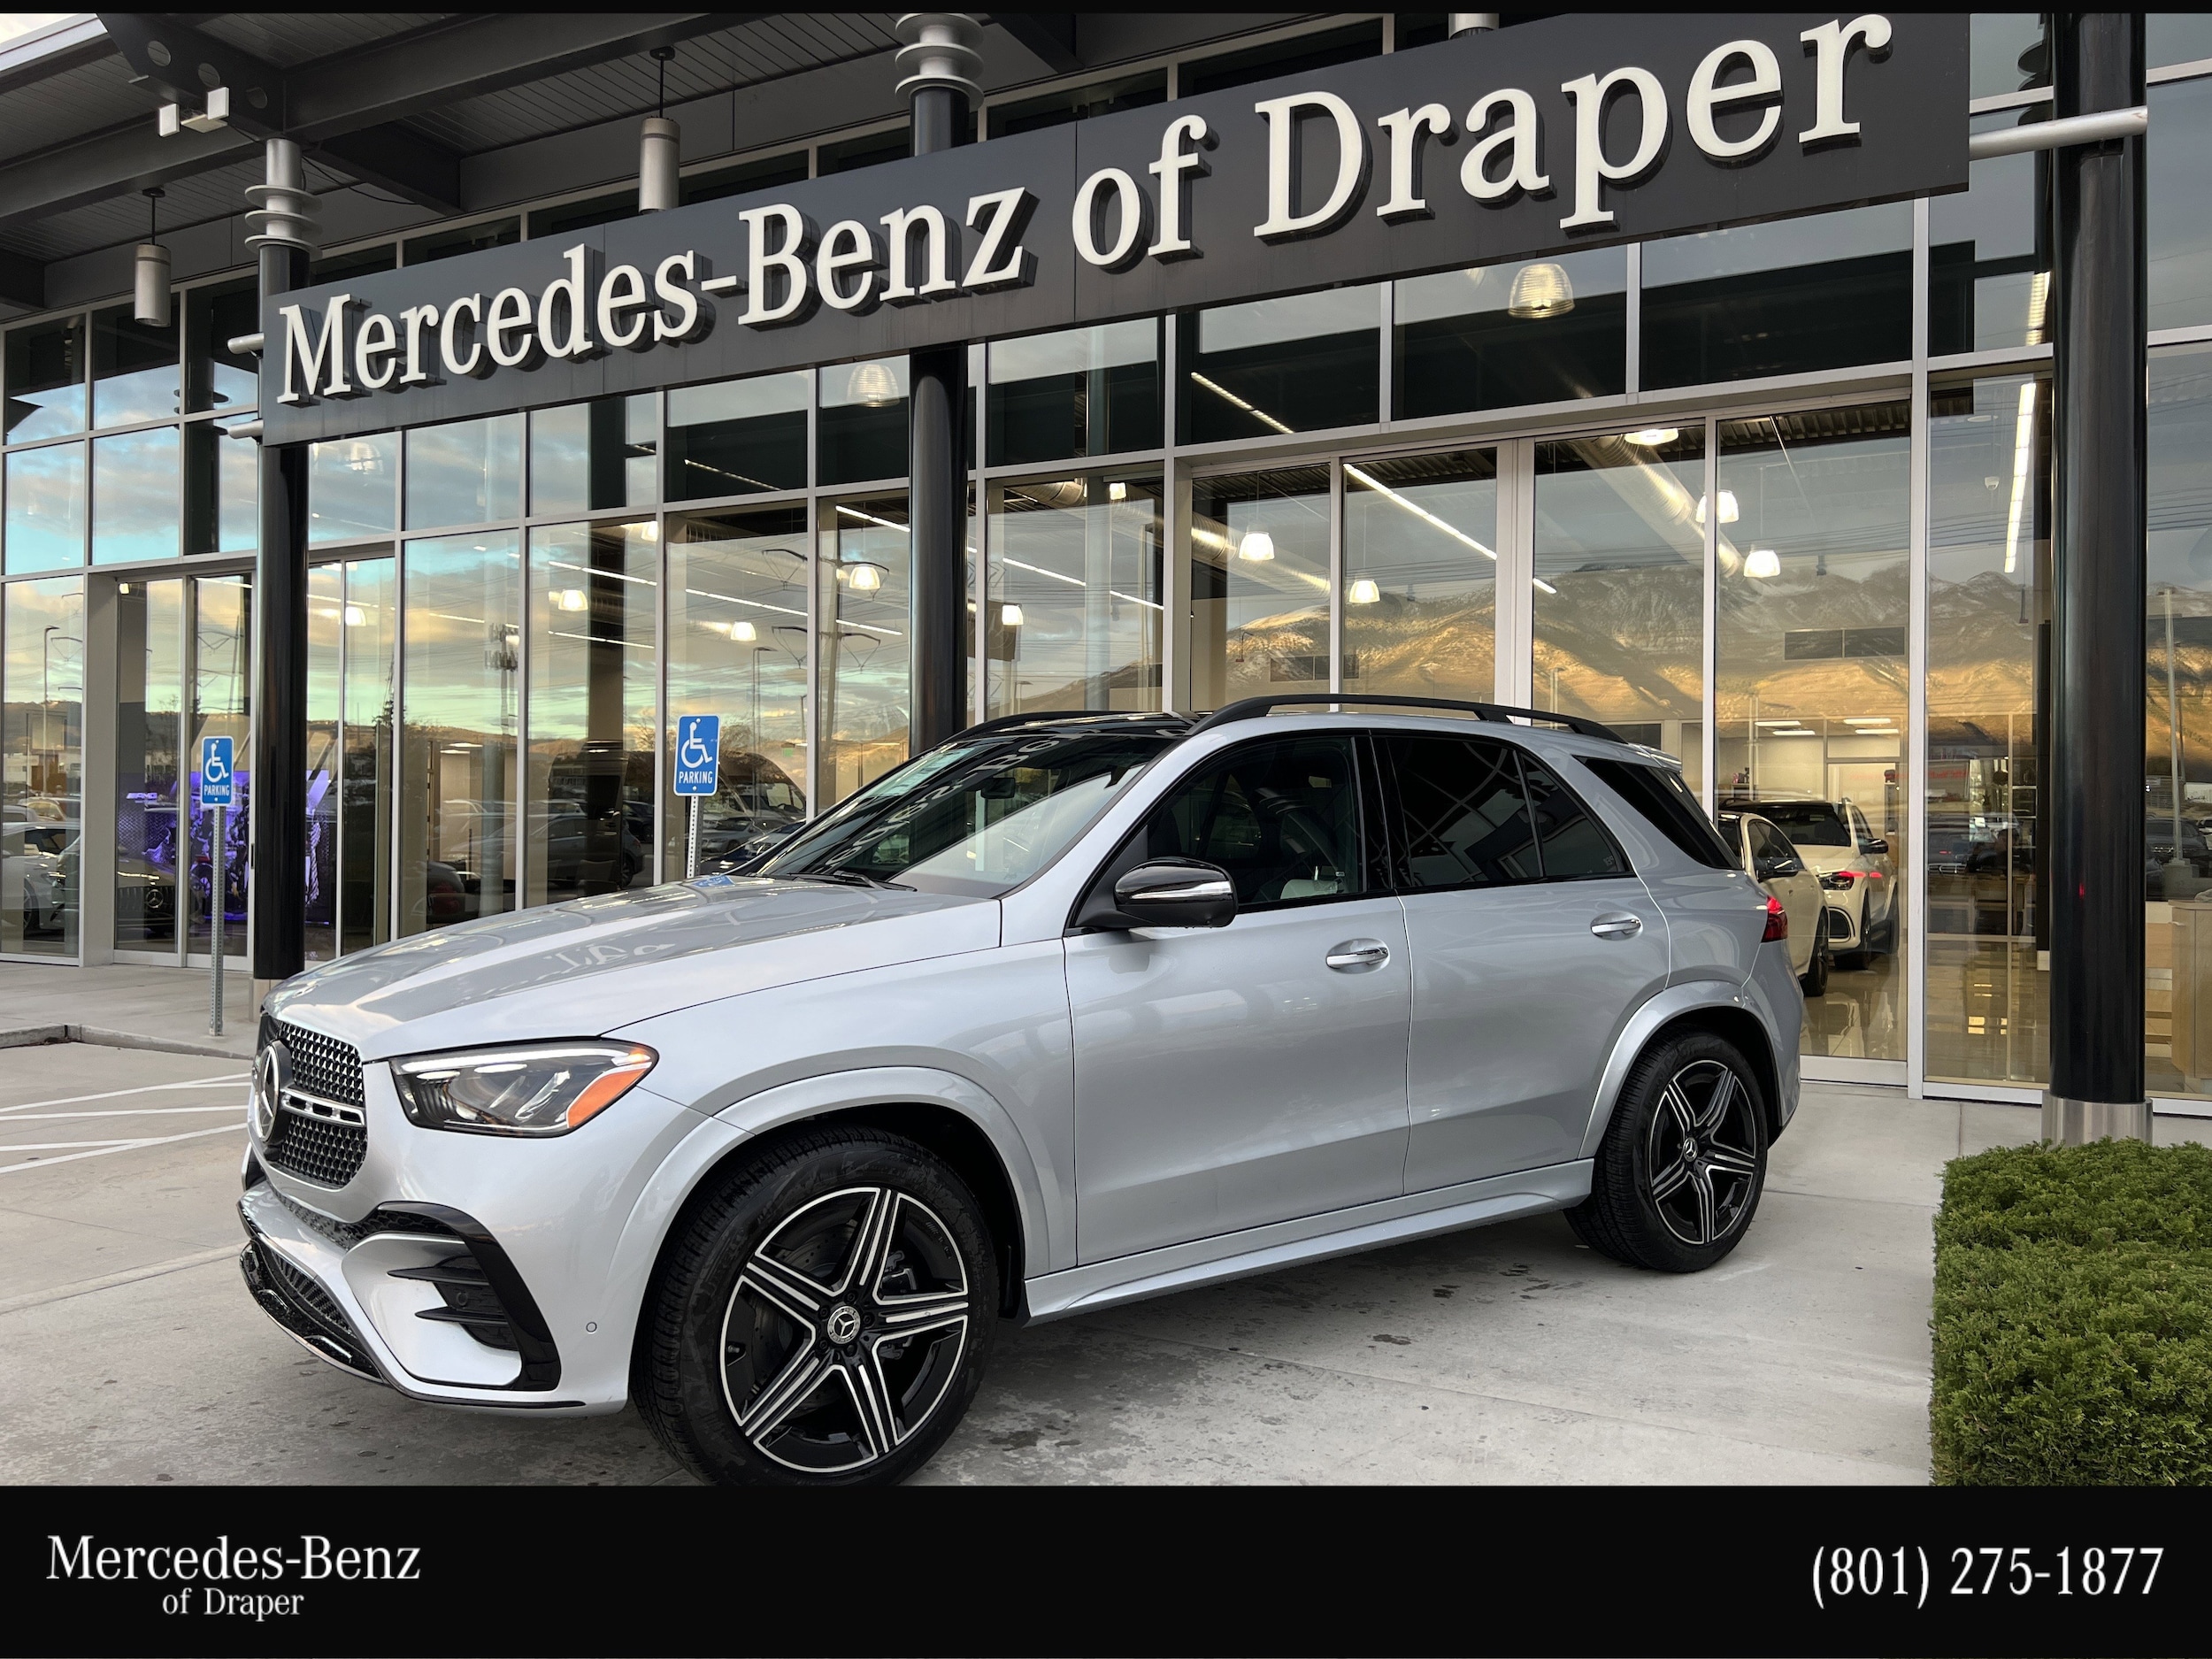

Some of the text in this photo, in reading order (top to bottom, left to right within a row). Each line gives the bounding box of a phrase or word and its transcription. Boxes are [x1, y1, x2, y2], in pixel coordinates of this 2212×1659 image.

[277, 13, 1893, 404] Mercedes-Benz of Draper
[678, 771, 713, 784] PARKING
[204, 784, 230, 796] PARKING
